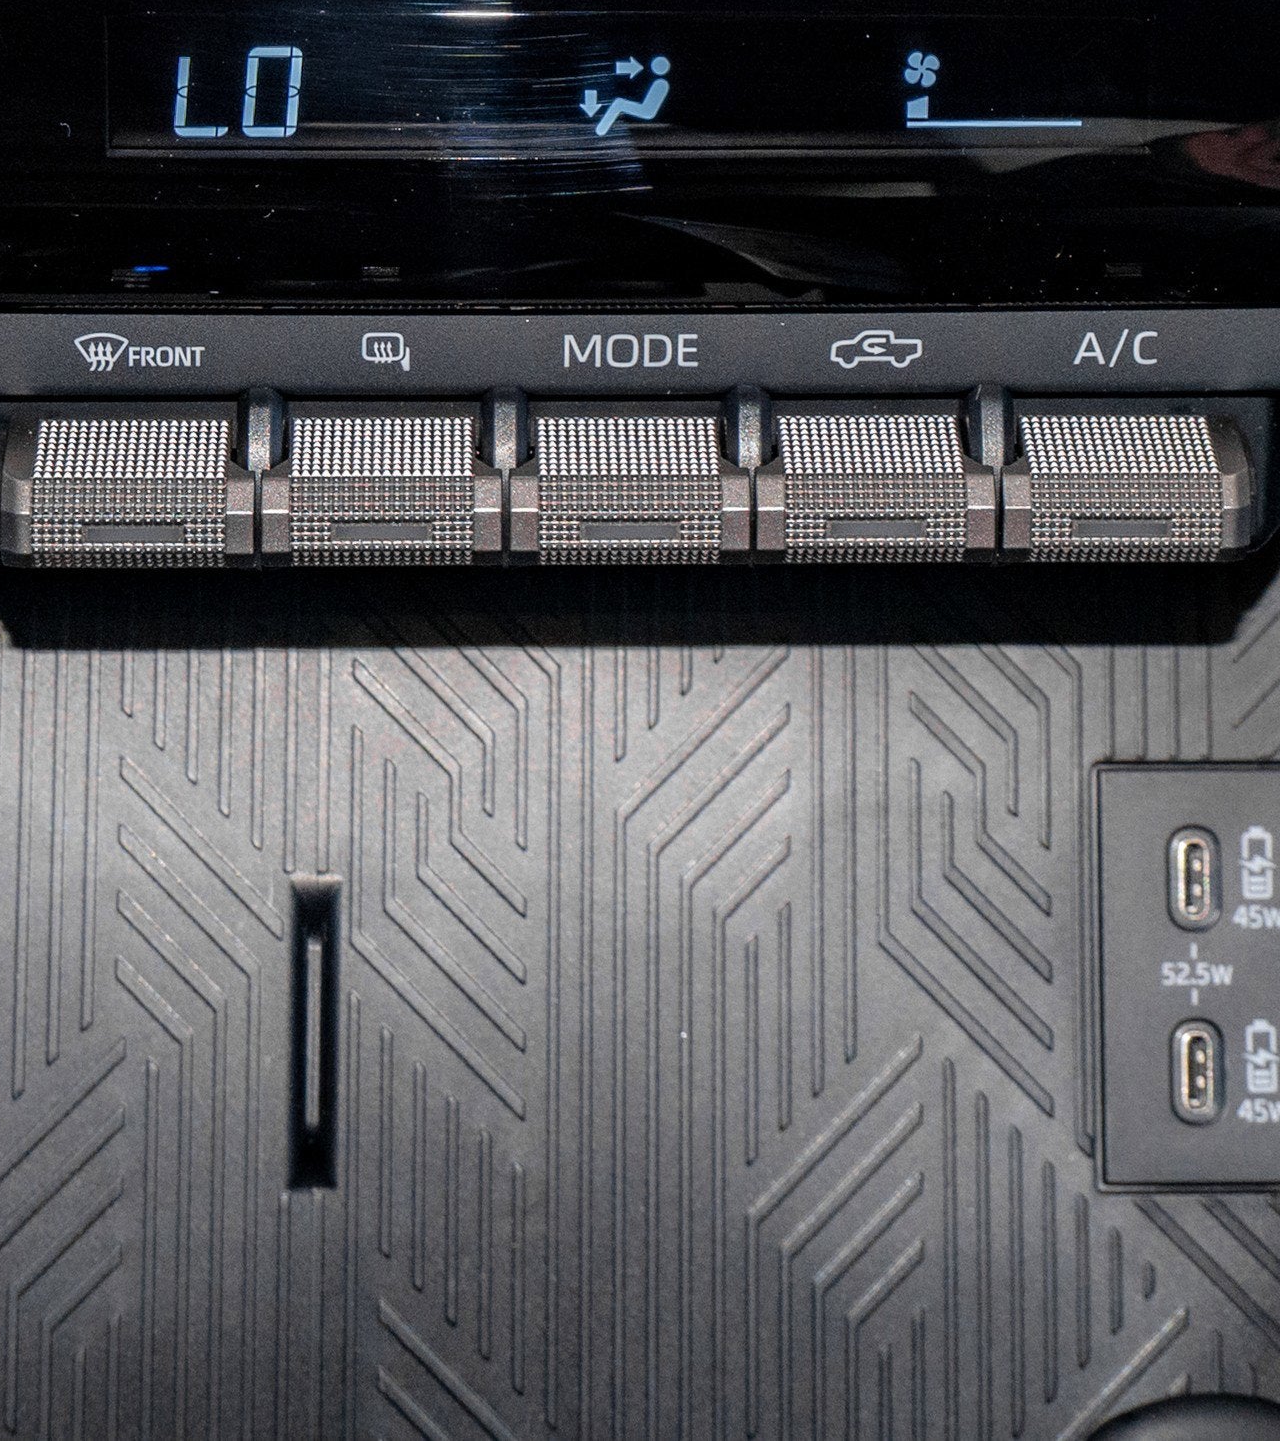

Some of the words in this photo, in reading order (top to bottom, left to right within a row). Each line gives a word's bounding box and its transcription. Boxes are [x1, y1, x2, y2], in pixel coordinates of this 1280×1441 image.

[174, 46, 303, 140] LO
[128, 345, 206, 368] FRONT
[563, 333, 699, 368] MODE
[1073, 328, 1159, 368] A/C
[1160, 961, 1234, 987] 52.5W
